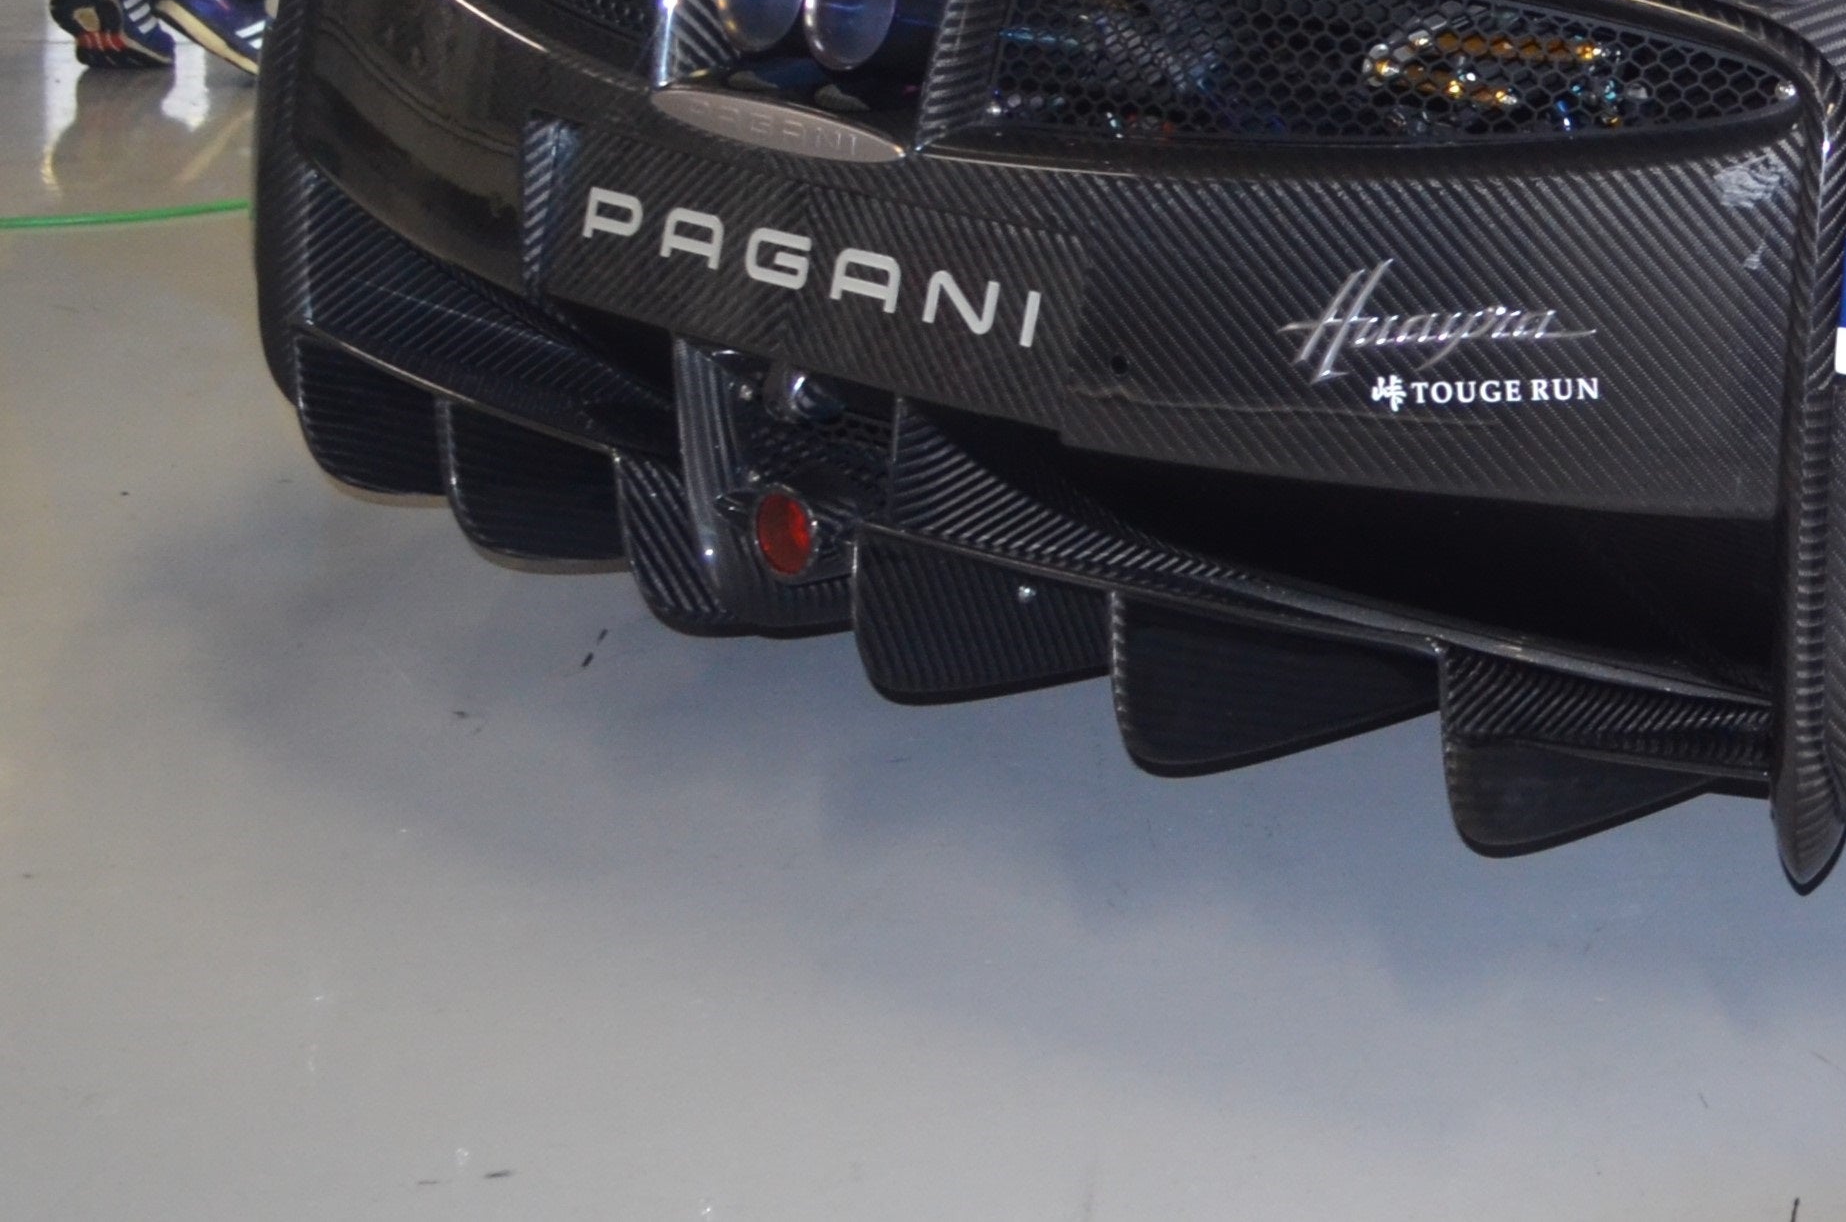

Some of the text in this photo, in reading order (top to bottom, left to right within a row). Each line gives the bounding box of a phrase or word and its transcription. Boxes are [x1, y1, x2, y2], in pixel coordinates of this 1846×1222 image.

[688, 99, 858, 156] PAGANI
[581, 186, 1042, 348] PAGANI
[1276, 257, 1598, 384] Huayra
[1371, 374, 1600, 413] 峠 TOUGE RUN
